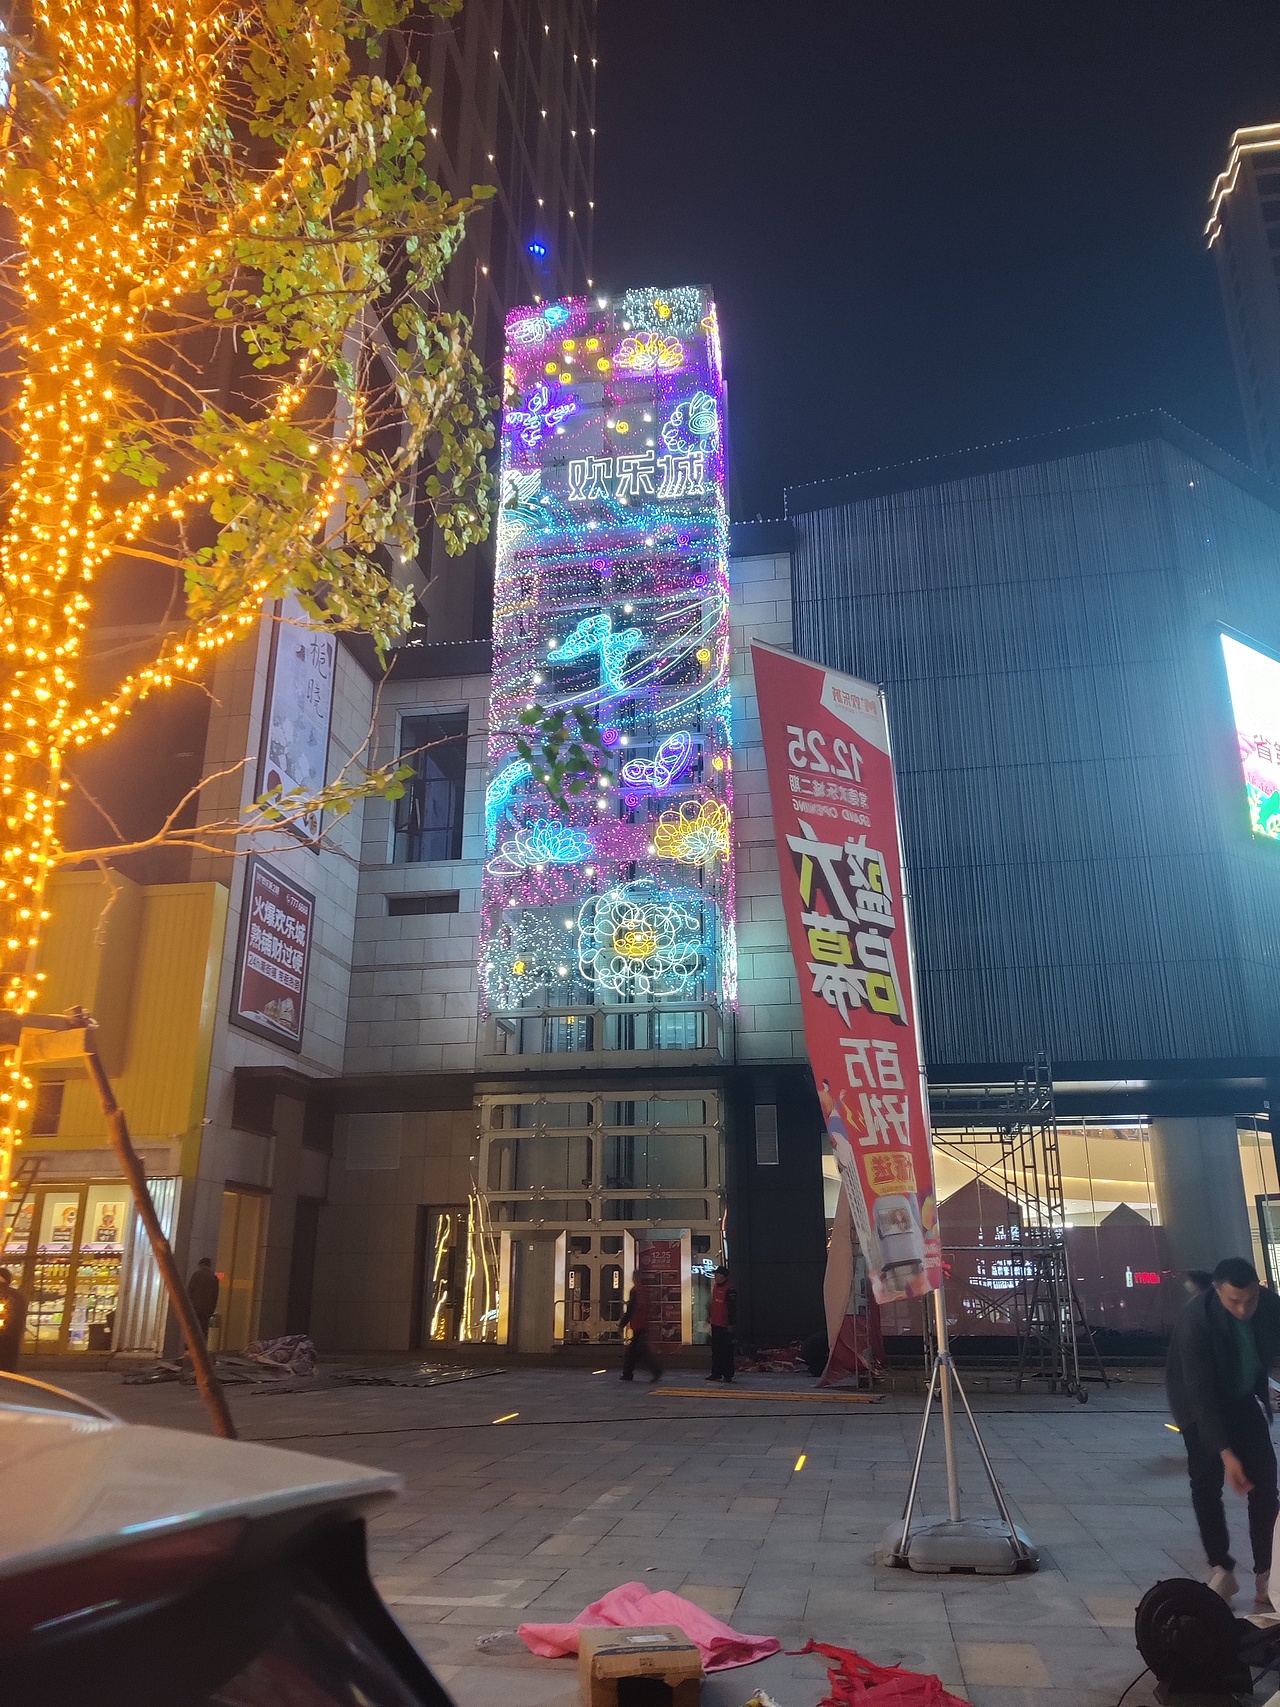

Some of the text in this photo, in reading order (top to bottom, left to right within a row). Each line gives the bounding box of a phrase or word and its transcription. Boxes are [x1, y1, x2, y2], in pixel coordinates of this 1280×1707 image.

[568, 450, 706, 501] 欢乐城
[253, 895, 306, 948] 火爆欢乐城
